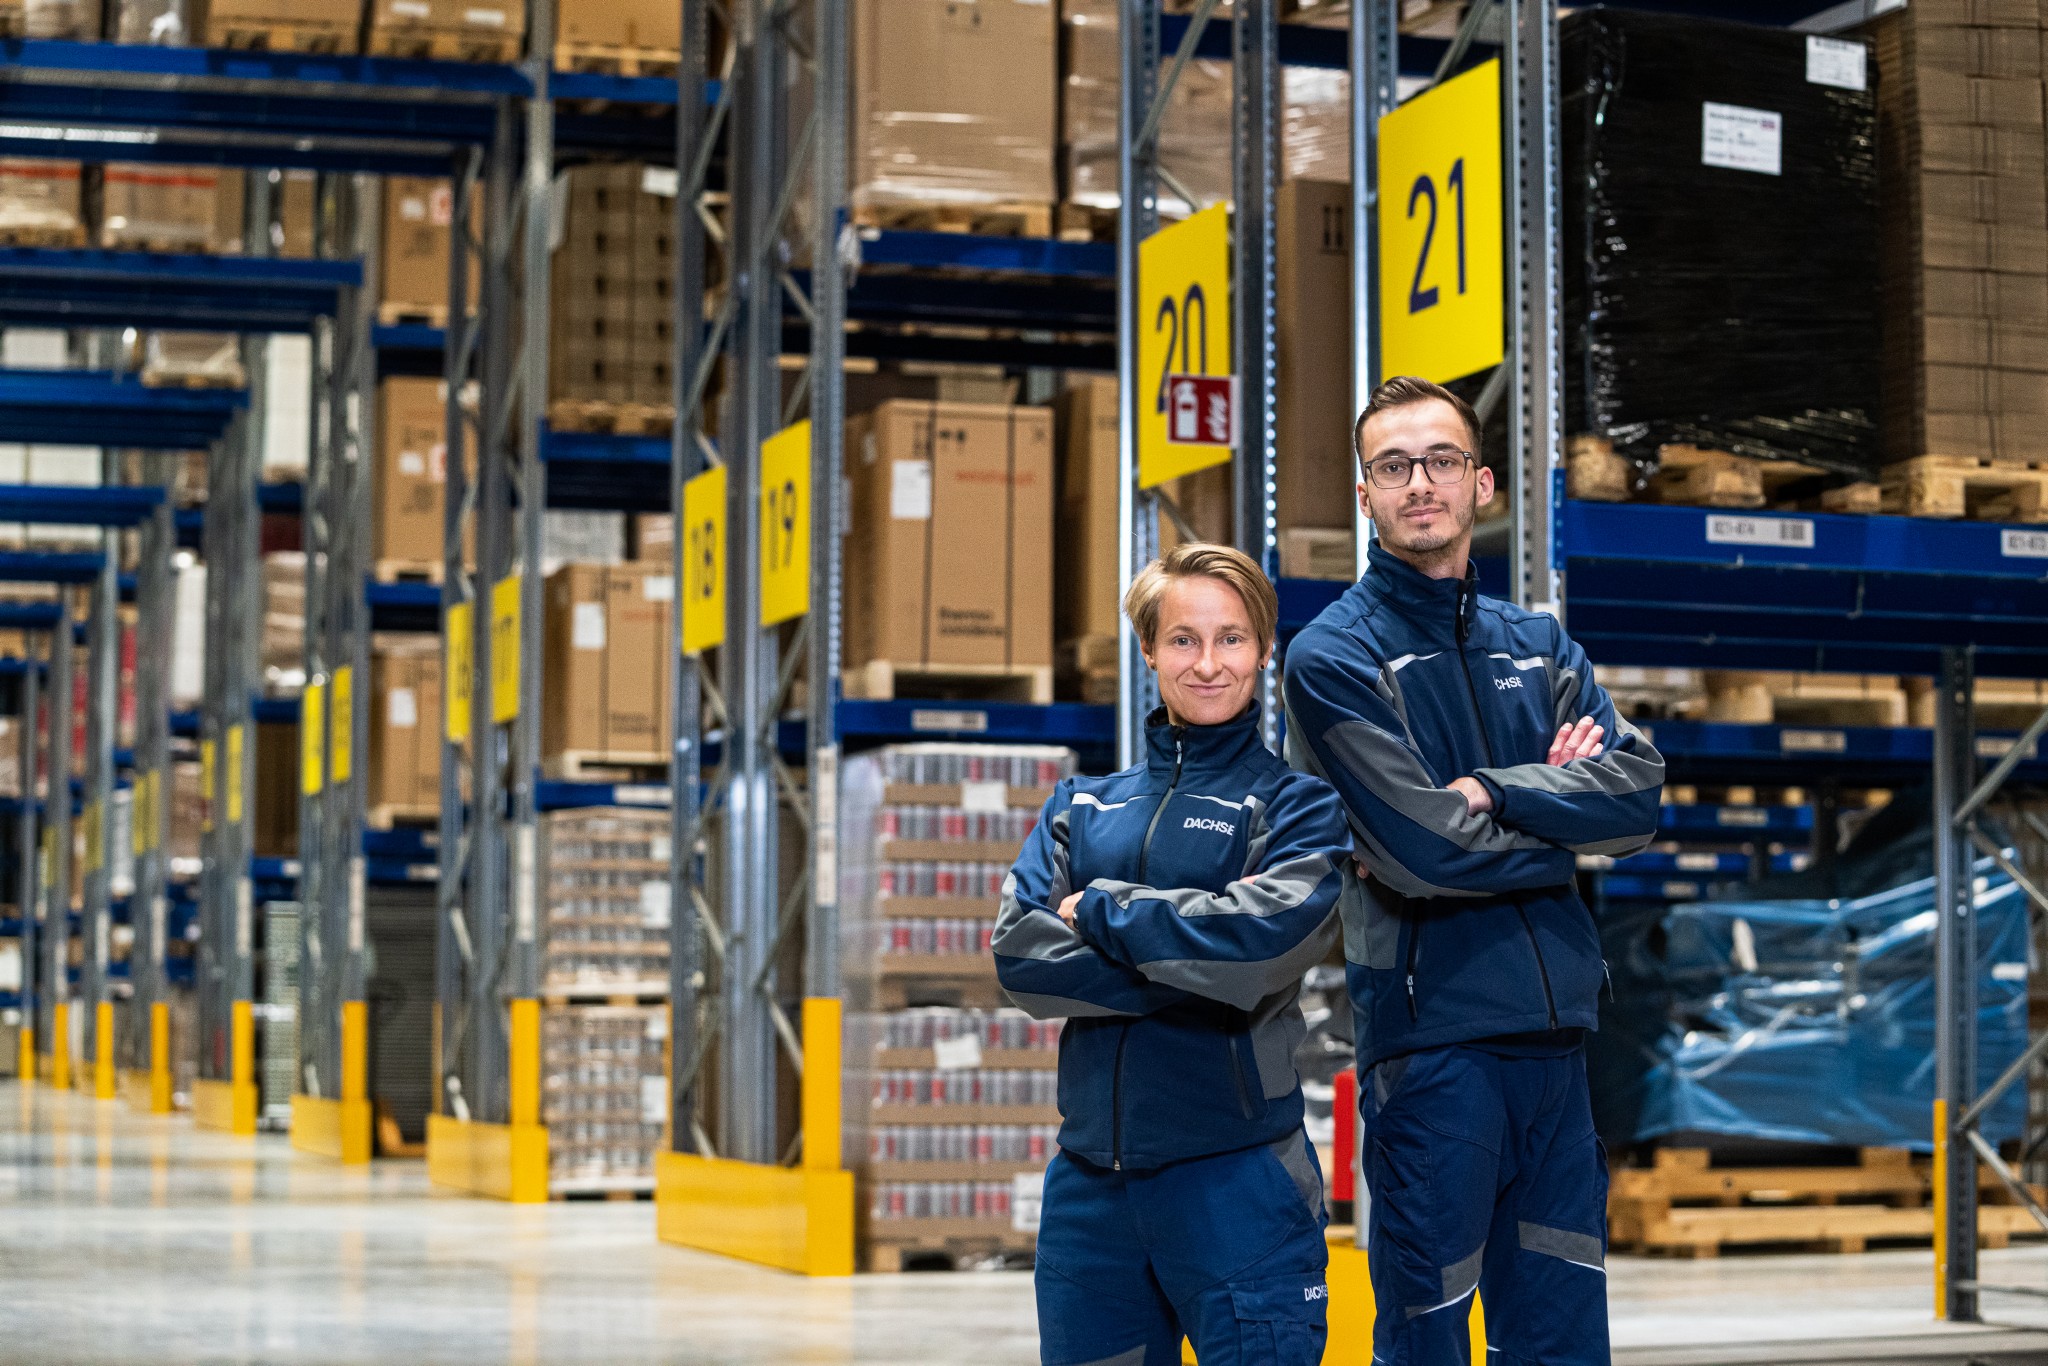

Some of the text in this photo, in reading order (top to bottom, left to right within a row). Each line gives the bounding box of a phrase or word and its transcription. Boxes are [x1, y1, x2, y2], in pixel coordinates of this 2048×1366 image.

[1406, 157, 1466, 316] 21
[1156, 283, 1207, 414] 20
[691, 519, 717, 602] 18
[769, 480, 798, 573] 19
[1493, 675, 1524, 690] CHSE
[1183, 817, 1236, 837] DACHSE
